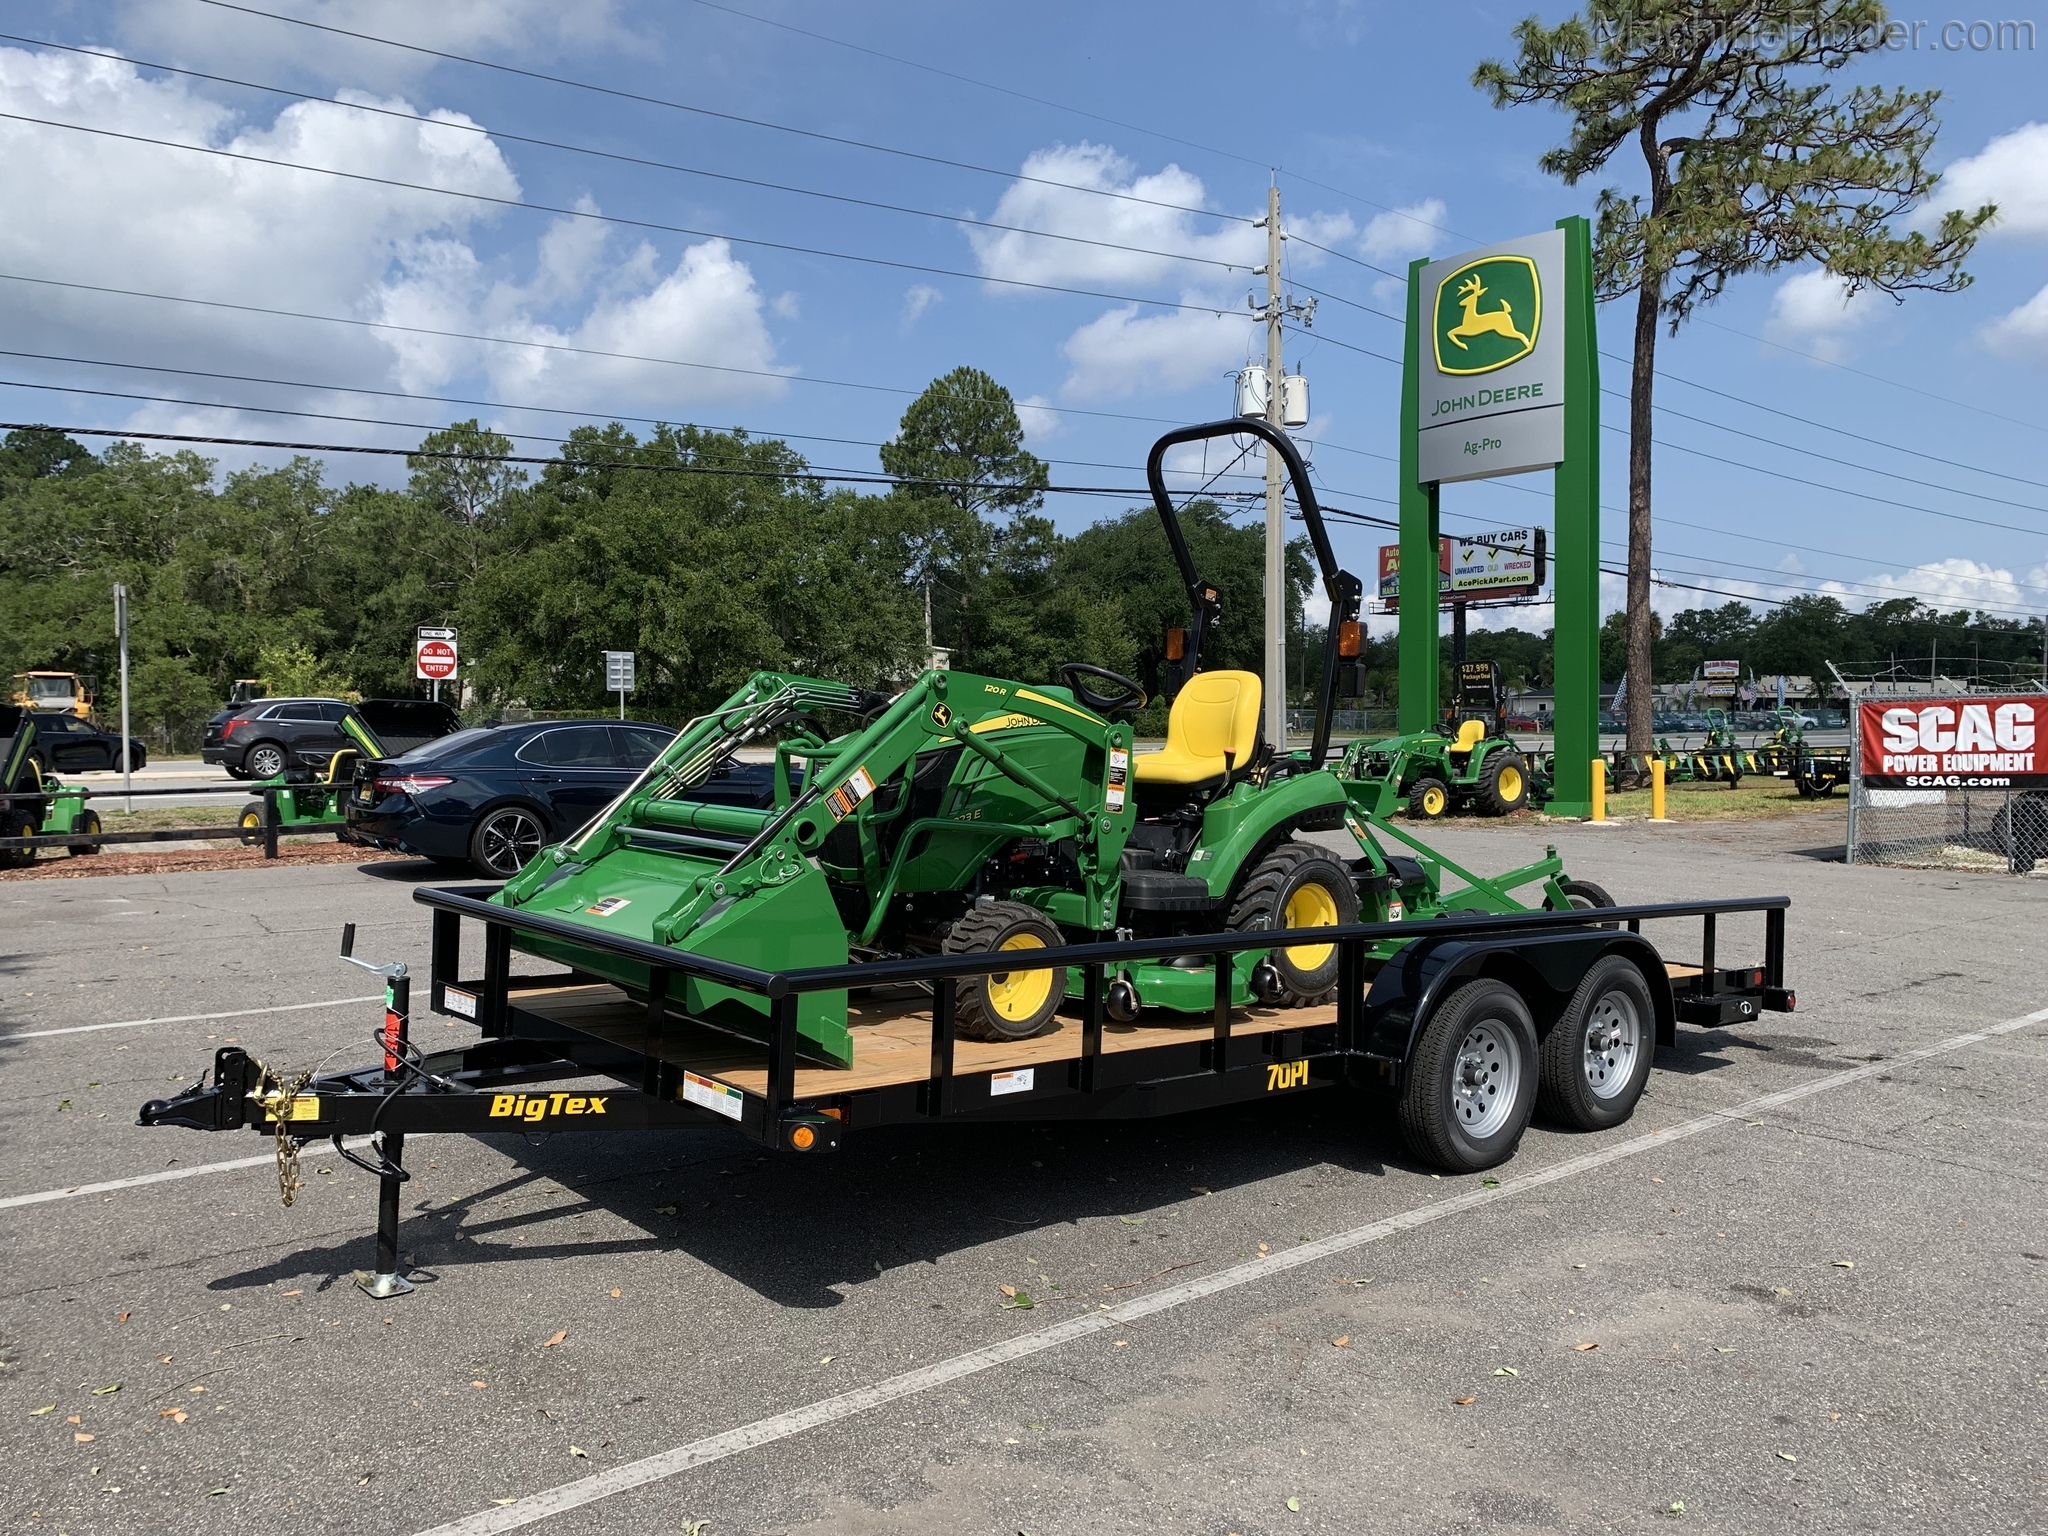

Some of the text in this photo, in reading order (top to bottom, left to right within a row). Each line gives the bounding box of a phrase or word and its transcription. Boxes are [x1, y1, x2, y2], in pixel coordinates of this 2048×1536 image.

[1431, 383, 1544, 417] JOHN DEERE
[1464, 438, 1502, 455] Ag-Pro
[1459, 530, 1528, 547] WE BUY CARS
[1455, 561, 1532, 575] UNWANTED OLD WRECKED
[1458, 575, 1529, 587] AcePickAPart.com
[1382, 586, 1395, 595] MAIN
[1882, 703, 2036, 753] SCAG
[1883, 752, 2036, 773] POWER EQUIPMENT
[1905, 775, 2010, 787] SCAG.com
[1267, 1059, 1309, 1091] 70PI
[489, 1093, 609, 1122] BigTex
